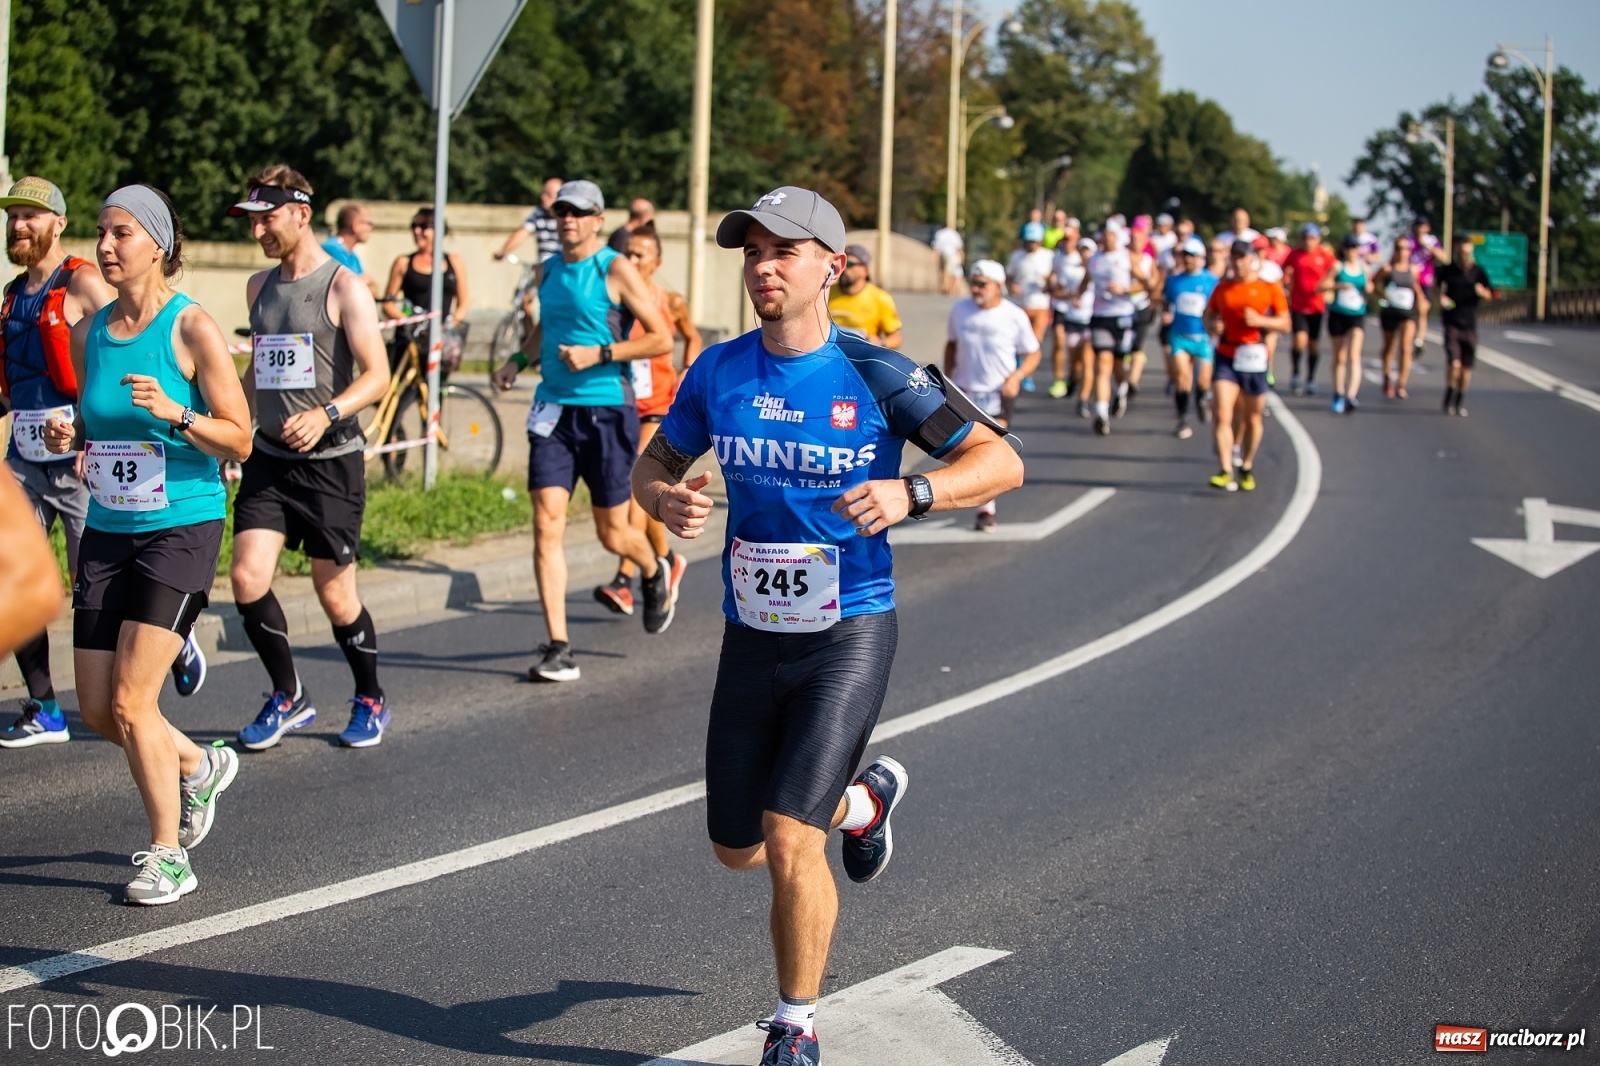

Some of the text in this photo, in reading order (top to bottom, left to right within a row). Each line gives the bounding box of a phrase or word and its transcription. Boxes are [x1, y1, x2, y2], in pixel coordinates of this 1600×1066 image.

[269, 349, 296, 367] 303
[709, 433, 876, 475] UNNERS
[112, 460, 138, 483] 43
[800, 478, 841, 489] TEAM
[755, 547, 790, 555] RAFAKO
[754, 568, 809, 597] 245
